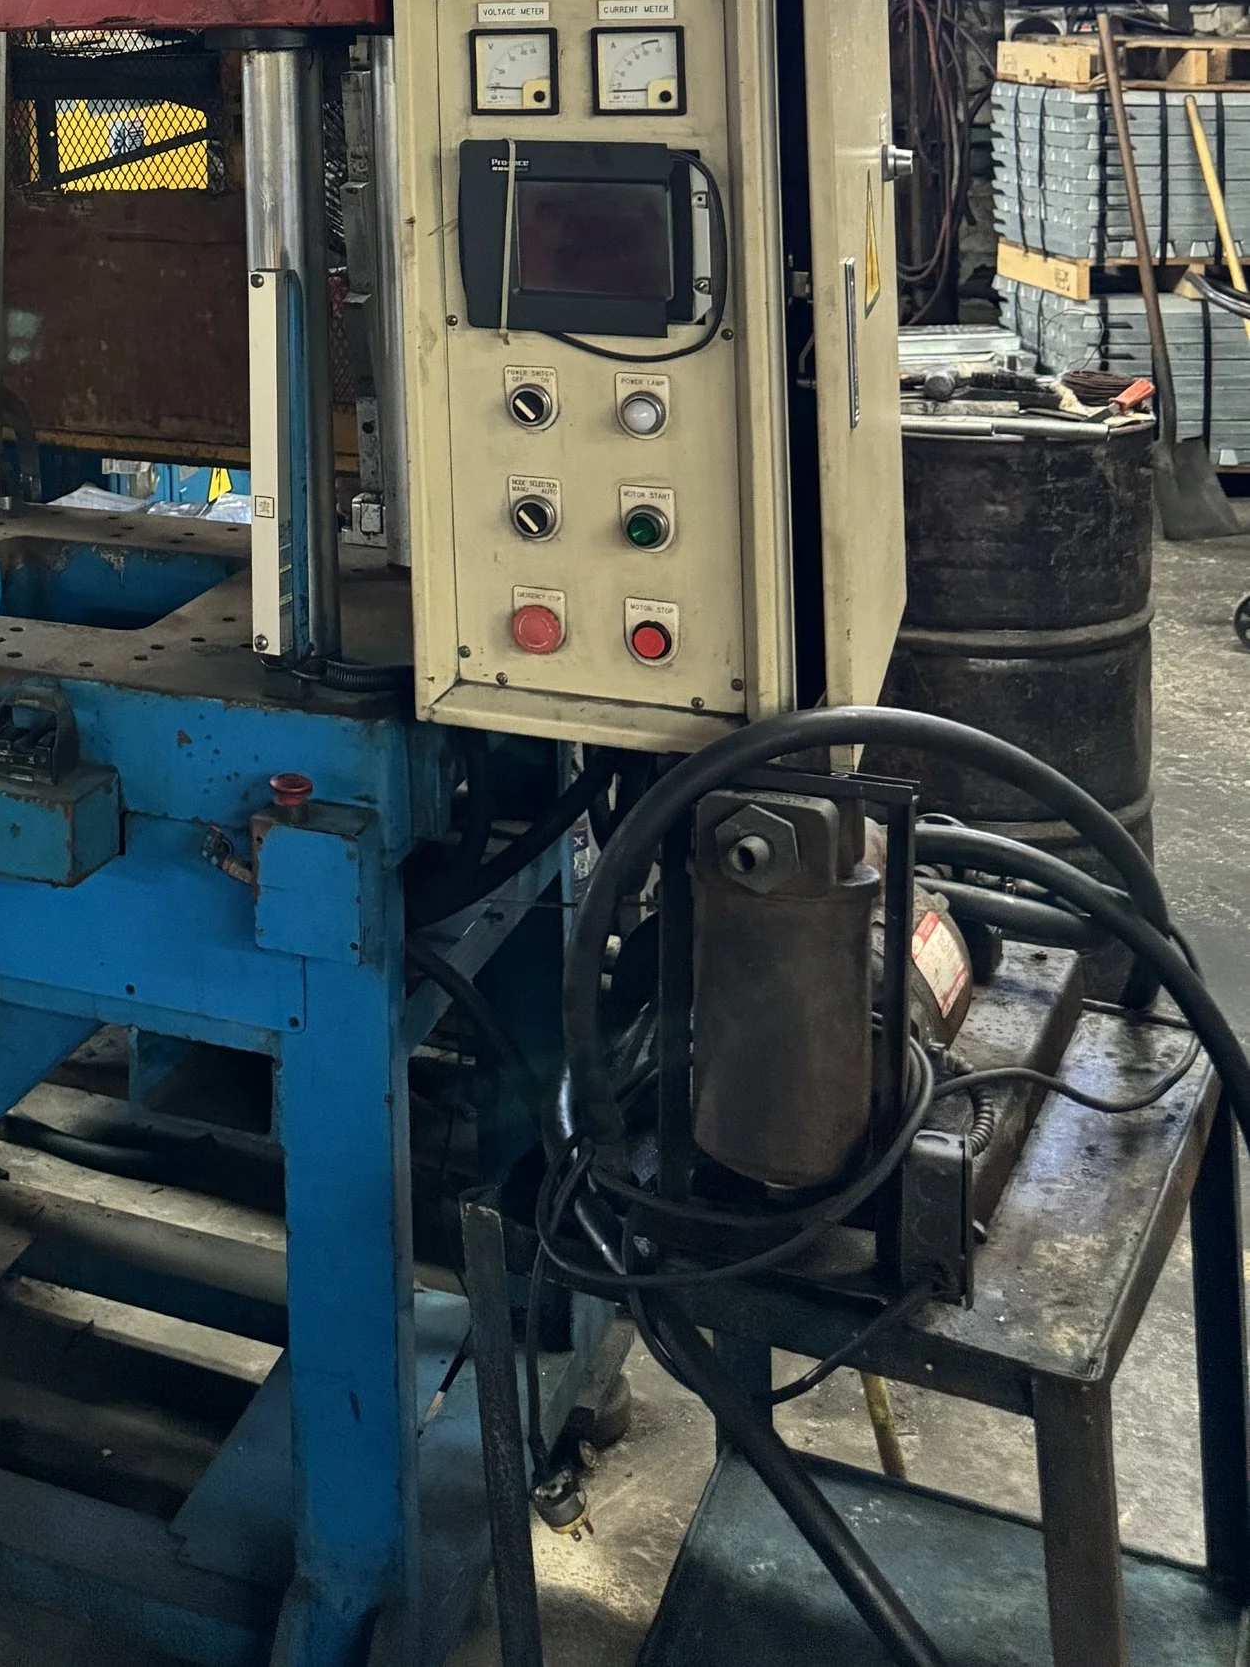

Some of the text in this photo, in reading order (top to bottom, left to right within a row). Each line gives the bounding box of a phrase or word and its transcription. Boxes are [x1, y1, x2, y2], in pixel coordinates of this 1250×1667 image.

[483, 7, 544, 16] VOLTAGE METER
[603, 5, 669, 14] CURRENT METER
[506, 368, 555, 378] POWER SWITCH
[620, 377, 644, 385] POWER
[529, 480, 557, 489] SELECTION
[541, 487, 558, 495] AUTO
[623, 490, 671, 501] MOTOR START
[630, 603, 674, 614] MOTOR STOP
